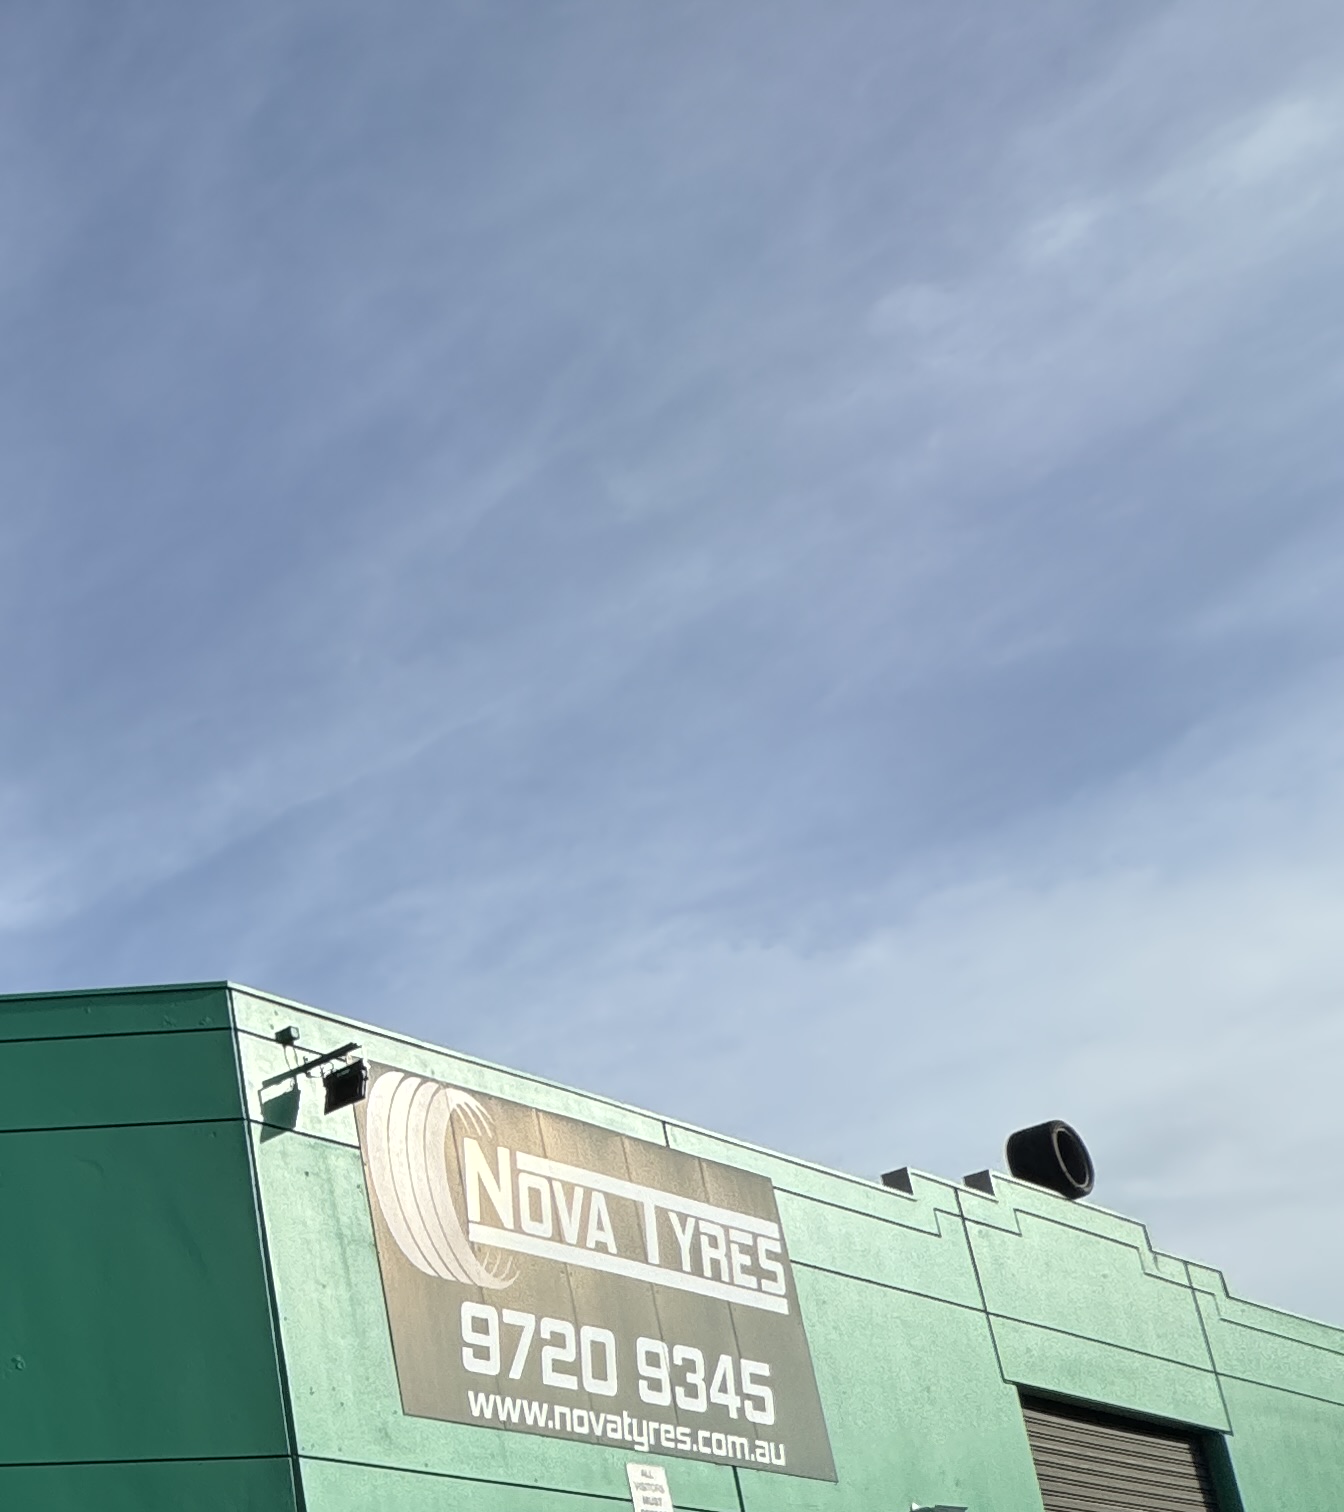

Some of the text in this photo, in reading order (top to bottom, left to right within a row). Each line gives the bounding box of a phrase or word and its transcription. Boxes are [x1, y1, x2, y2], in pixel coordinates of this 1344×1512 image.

[464, 1137, 787, 1296] NOVA TYRES
[461, 1301, 775, 1425] 9720 9345
[467, 1390, 787, 1466] www.novatyres.com.au
[642, 1496, 662, 1507] MUST
